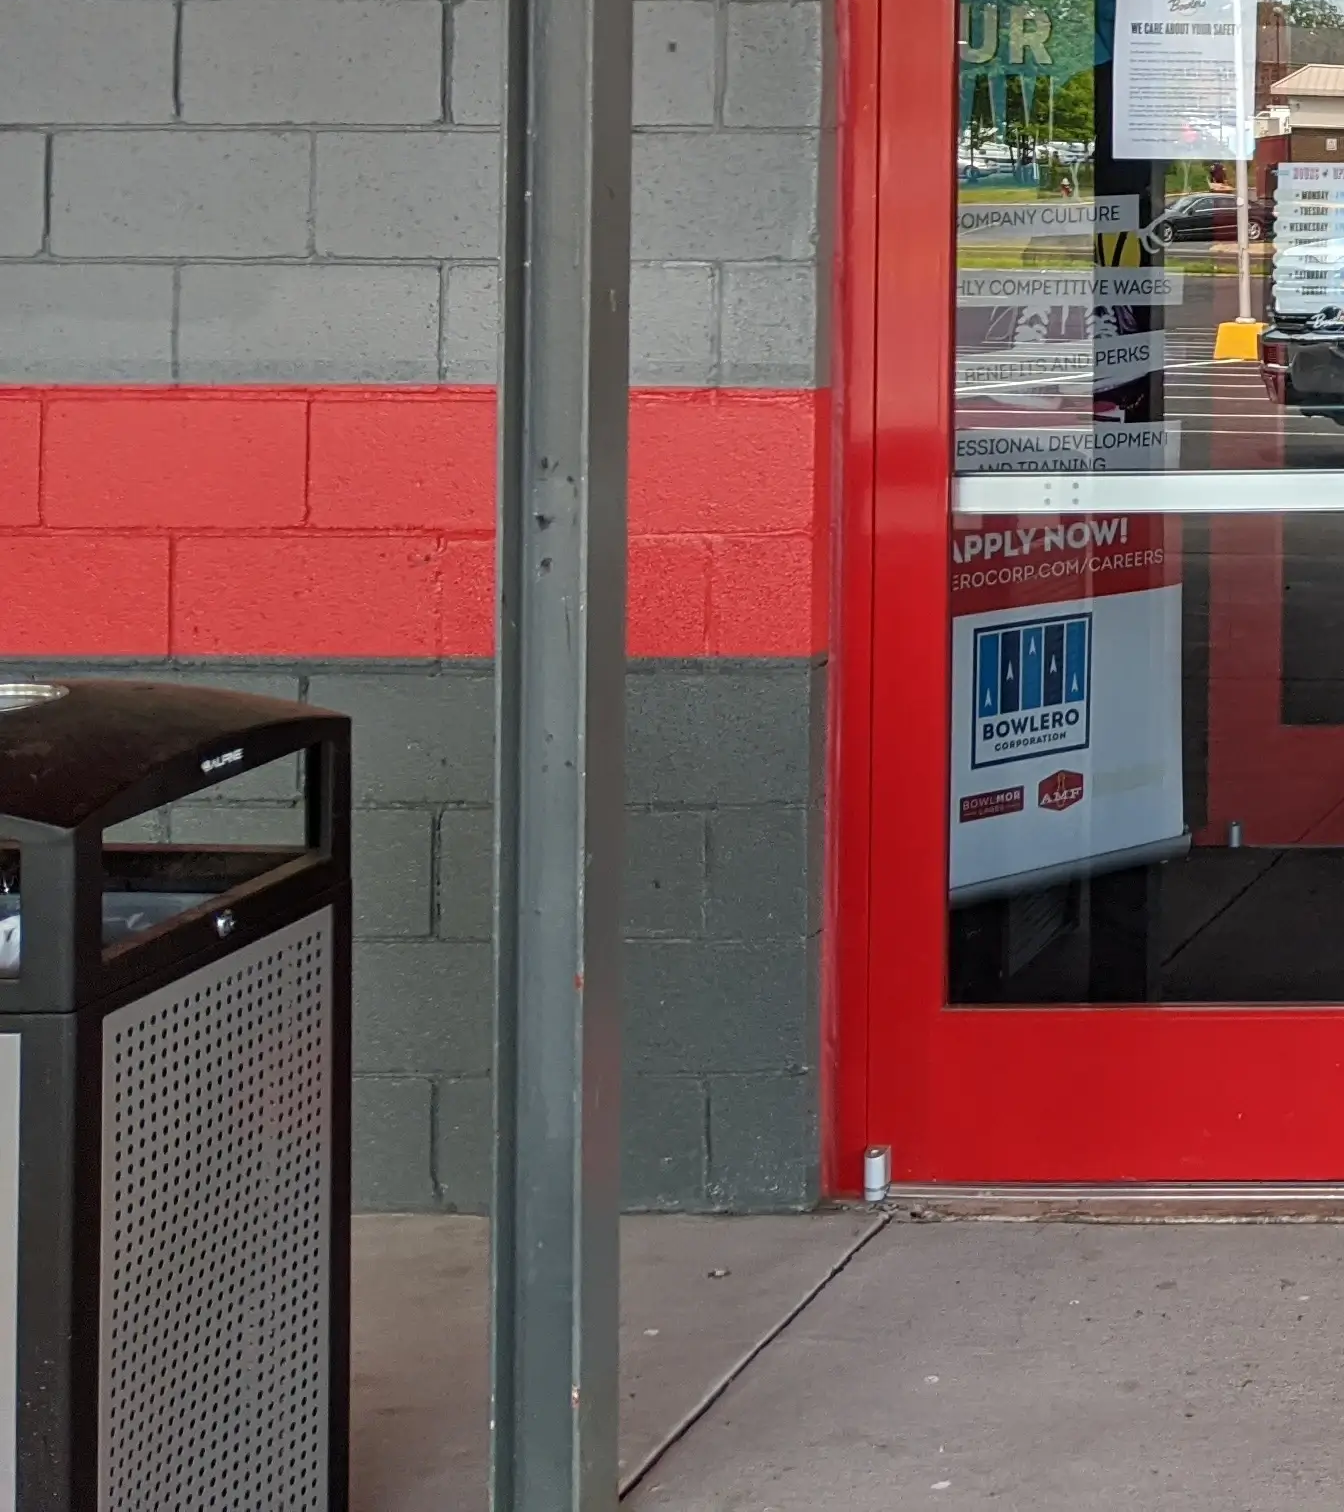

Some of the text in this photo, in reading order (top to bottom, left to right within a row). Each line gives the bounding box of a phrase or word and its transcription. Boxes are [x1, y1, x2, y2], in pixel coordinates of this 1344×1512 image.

[1131, 22, 1241, 36] WE CARE ABOUT YOUR SAFETY
[1302, 190, 1329, 200] MONDAY
[1041, 205, 1121, 225] CULTURE
[1300, 206, 1329, 216] TUESDAY
[1289, 222, 1328, 232] WEDNESDAY
[989, 279, 1109, 296] COMPETITIVE
[1112, 278, 1172, 295] WAGES
[964, 345, 1150, 384] BENEFITS AND PERKS
[1049, 430, 1168, 452] DEVELOPMENT
[1044, 517, 1128, 552] NOW!
[983, 708, 1080, 741] BOWLERO
[994, 731, 1067, 752] CORPORATION
[962, 790, 1021, 810] BOWLMOR
[1040, 787, 1082, 806] AMF
